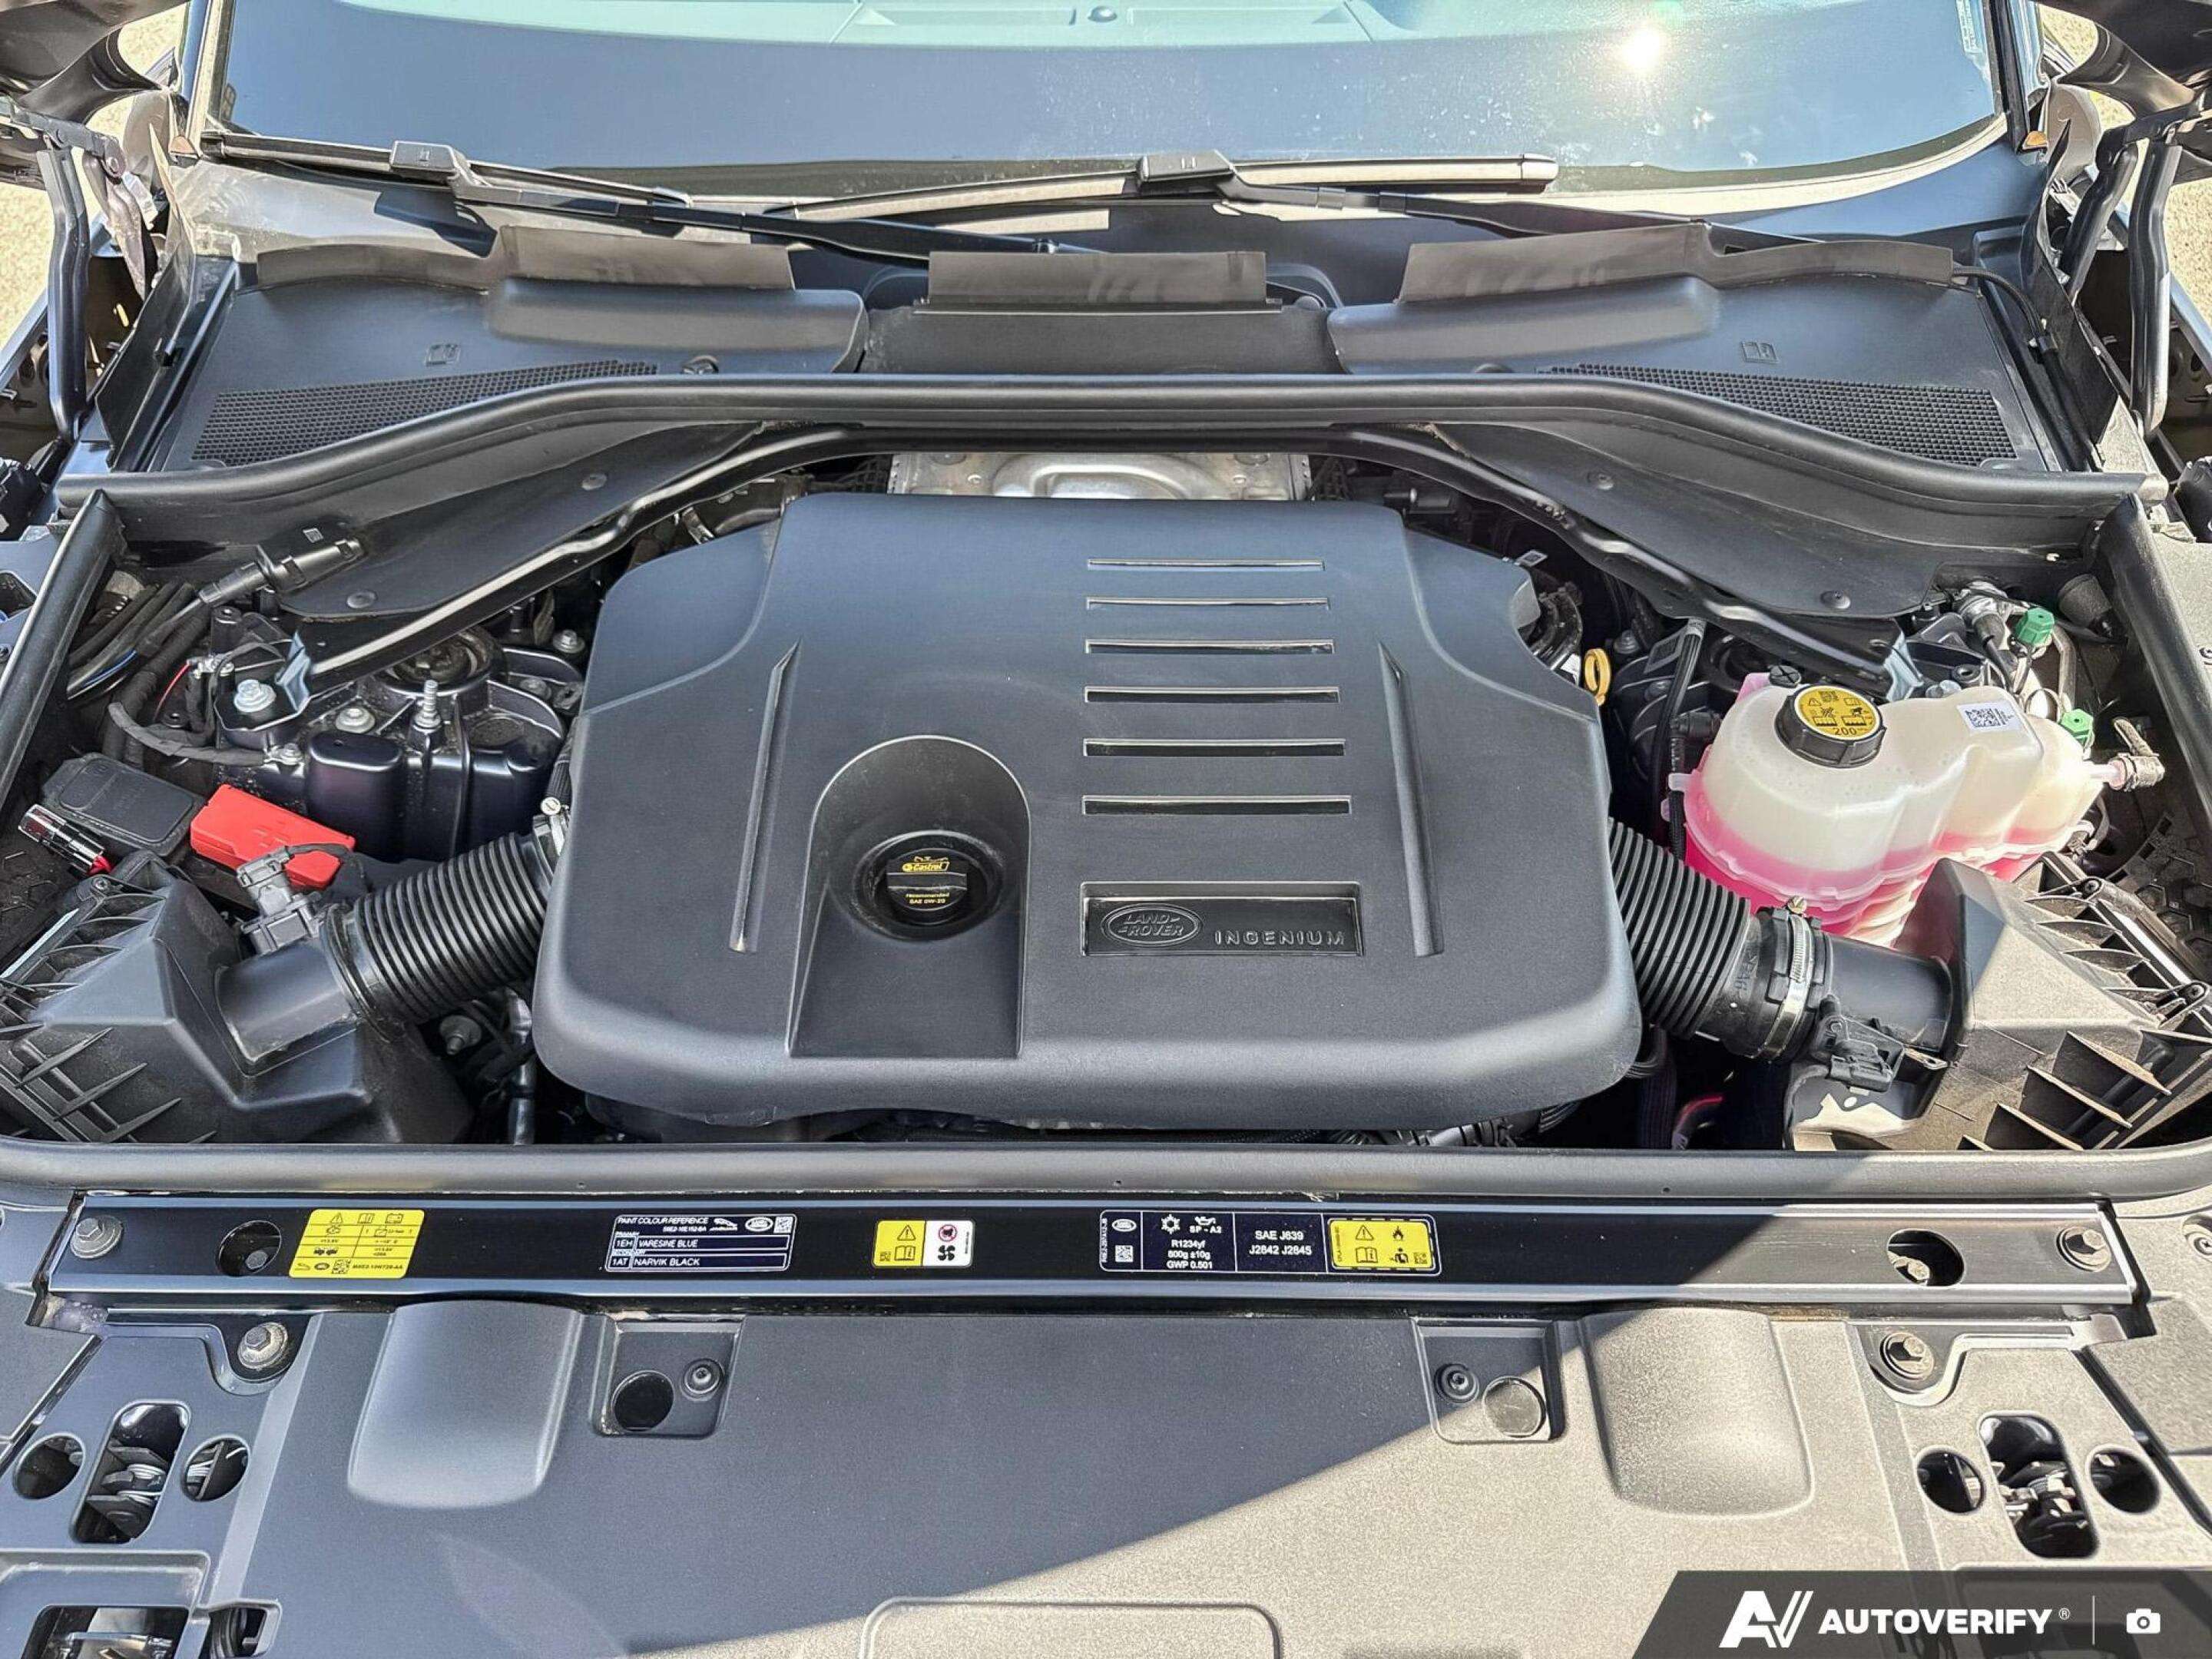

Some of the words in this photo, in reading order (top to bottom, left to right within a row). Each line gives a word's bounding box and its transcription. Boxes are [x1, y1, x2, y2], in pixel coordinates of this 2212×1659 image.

[914, 863, 942, 871] Castrol
[1214, 931, 1345, 945] INGENIUM
[1255, 1230, 1277, 1240] SAE
[1280, 1230, 1304, 1240] J639
[639, 1239, 676, 1248] VARESINE
[677, 1239, 698, 1248] BLUE
[1171, 1239, 1206, 1250] R1234yf
[612, 1257, 629, 1267] 1AT
[634, 1257, 667, 1267] NARVIK
[669, 1257, 700, 1267] BLACK
[1166, 1260, 1189, 1269] GWP
